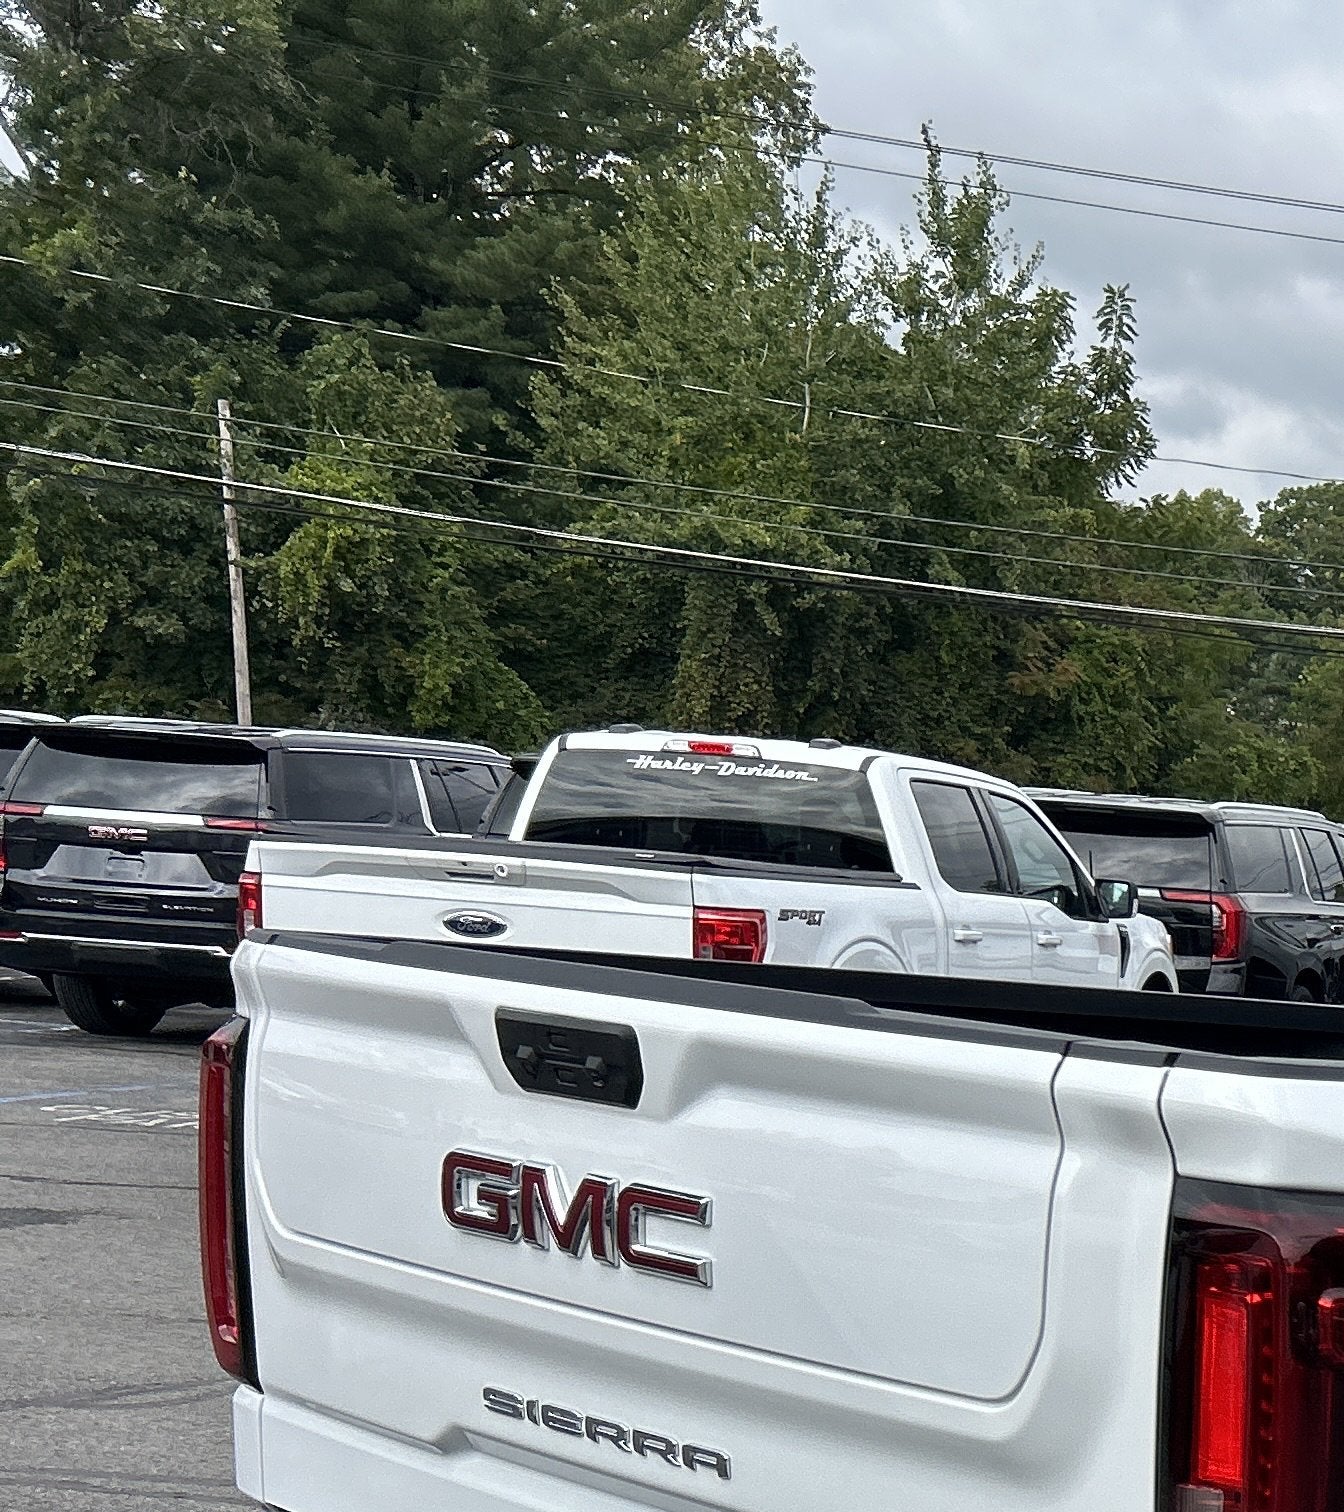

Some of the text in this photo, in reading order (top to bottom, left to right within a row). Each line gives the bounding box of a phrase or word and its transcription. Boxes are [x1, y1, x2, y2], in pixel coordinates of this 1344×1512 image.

[626, 754, 819, 782] Harley-Davidson
[88, 825, 148, 841] GMC
[457, 915, 493, 933] Ford
[441, 1147, 713, 1288] GMC
[482, 1386, 732, 1480] SIERRA
